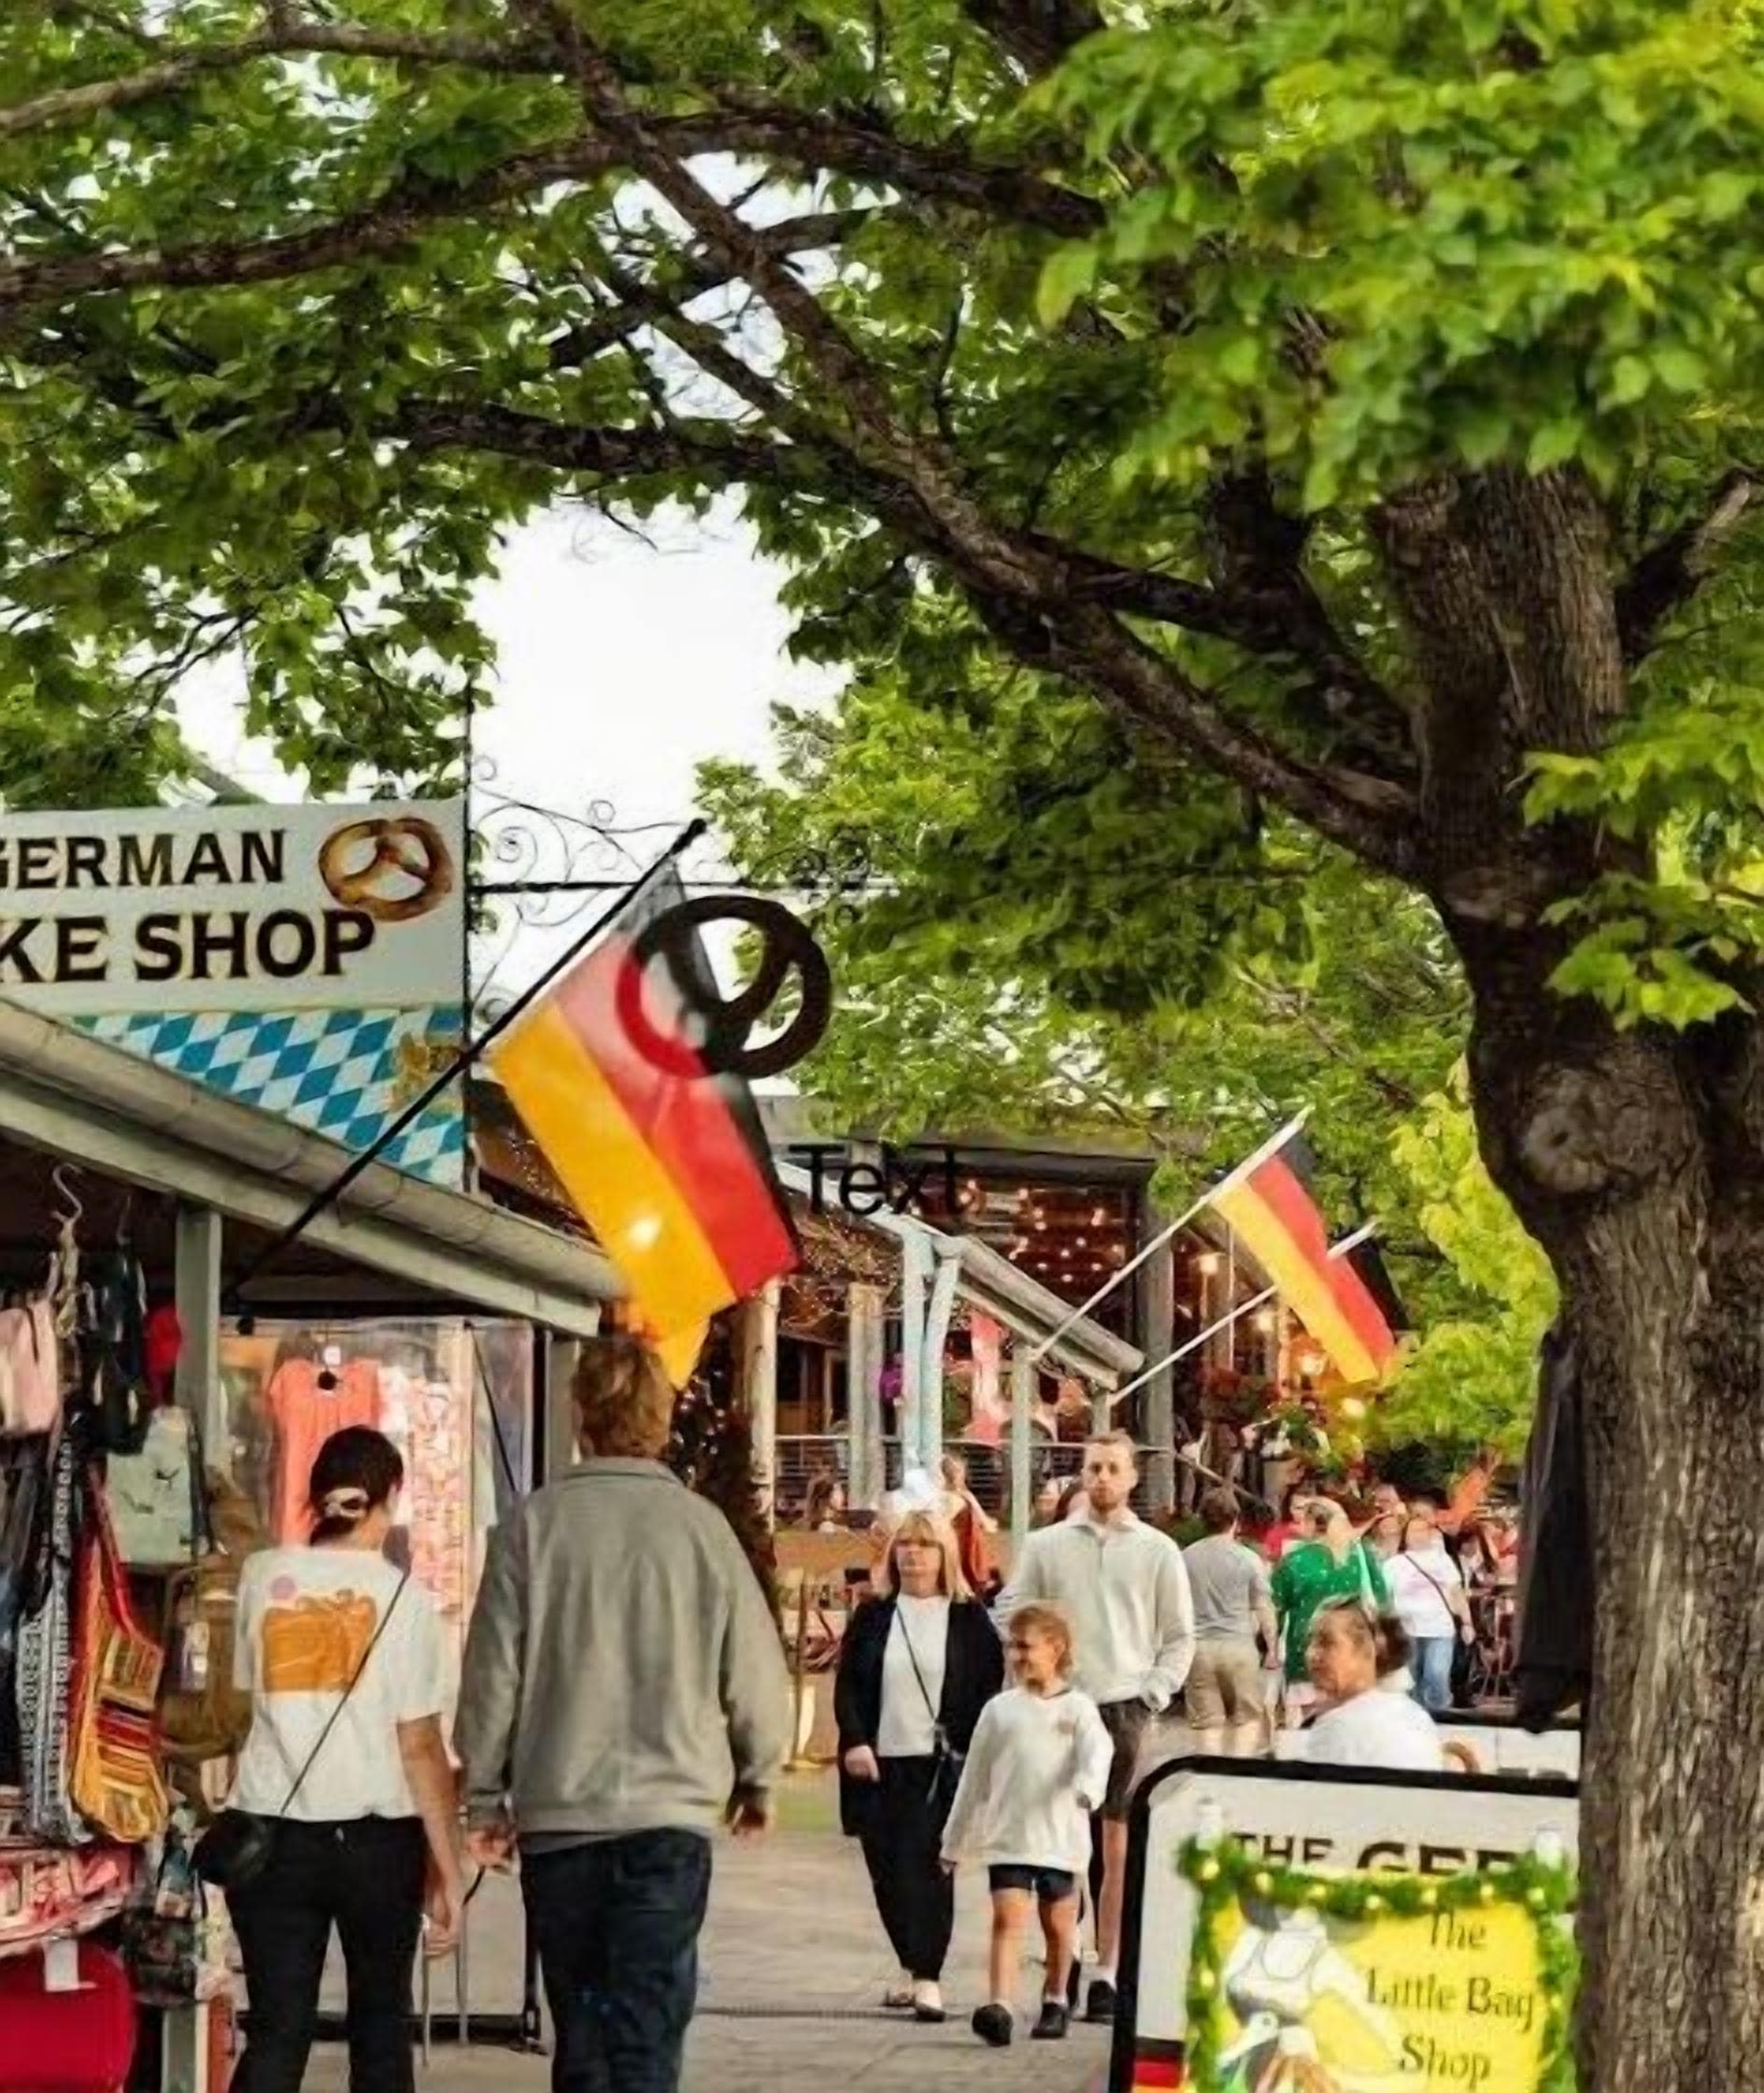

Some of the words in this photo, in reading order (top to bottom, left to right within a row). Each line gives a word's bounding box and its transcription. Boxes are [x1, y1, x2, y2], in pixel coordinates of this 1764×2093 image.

[0, 828, 284, 889] ERMAN
[0, 915, 109, 983] KE
[134, 909, 376, 983] SHOP
[1367, 1966, 1458, 2013] Little
[1467, 1975, 1533, 2034] Bag
[1399, 2032, 1492, 2091] Shop
